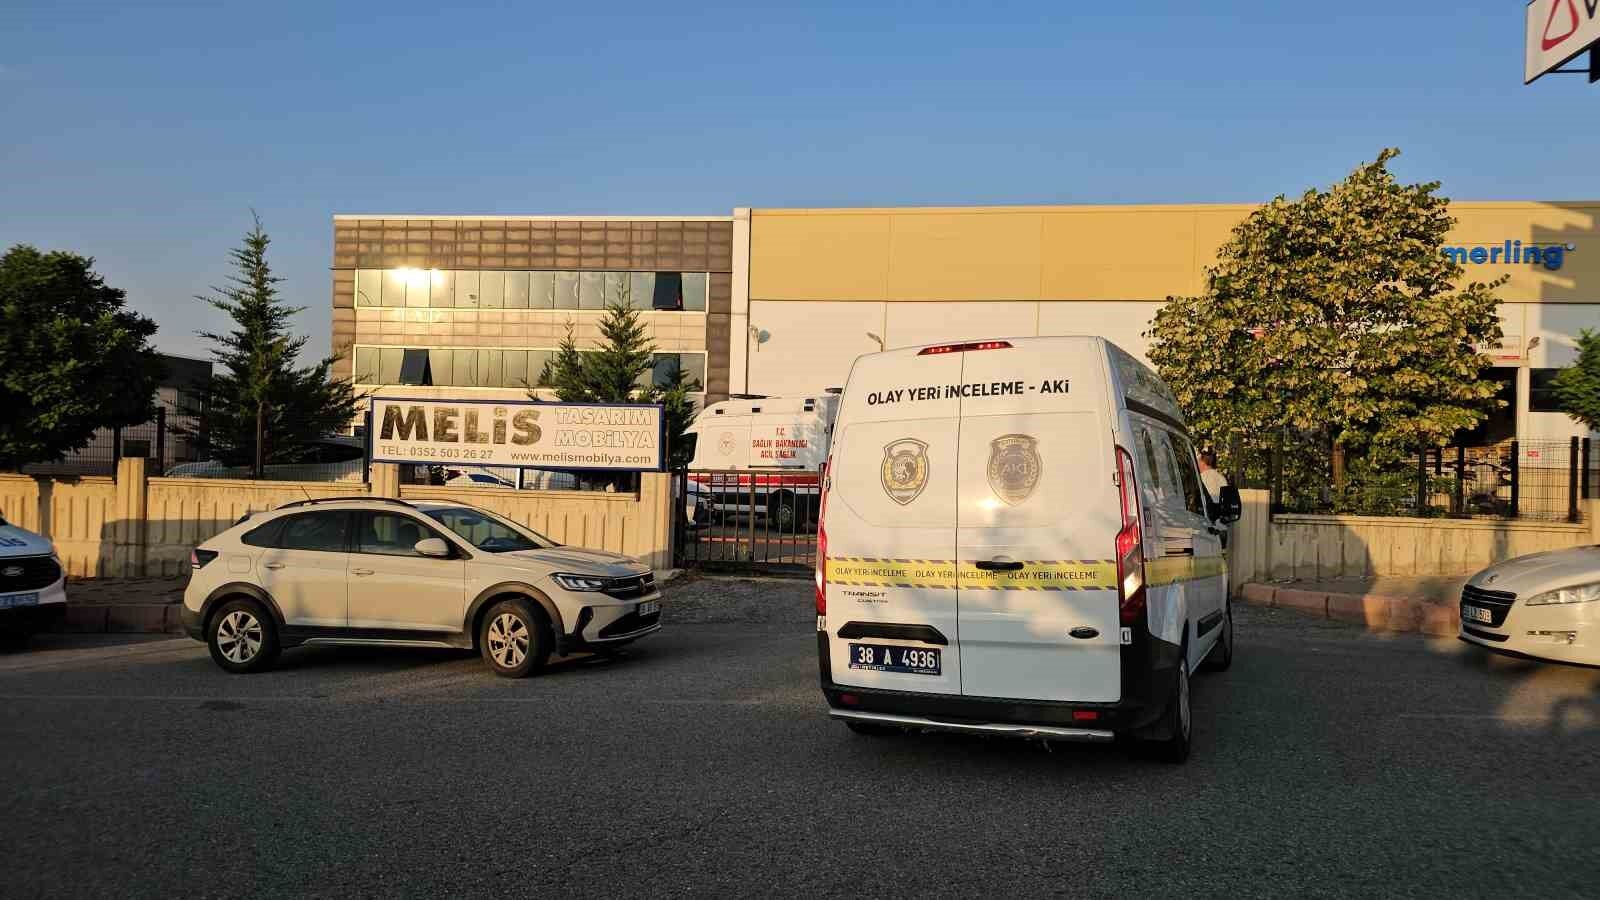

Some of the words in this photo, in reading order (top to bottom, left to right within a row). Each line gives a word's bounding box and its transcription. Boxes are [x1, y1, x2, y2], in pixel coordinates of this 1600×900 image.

[1440, 240, 1564, 271] merling
[867, 390, 904, 406] OLAY
[554, 407, 653, 426] TASARIM
[382, 446, 406, 456] TEL:
[410, 446, 437, 457] 0352
[440, 448, 460, 458] 503
[463, 449, 477, 459] 26
[480, 449, 494, 459] 27
[510, 452, 652, 467] www.melismobilya.com
[834, 567, 852, 576] OLAY
[915, 570, 936, 578] OLAY
[1007, 571, 1030, 580] OLAY
[858, 646, 874, 664] 38
[883, 648, 893, 665] A
[901, 649, 936, 669] 4936
